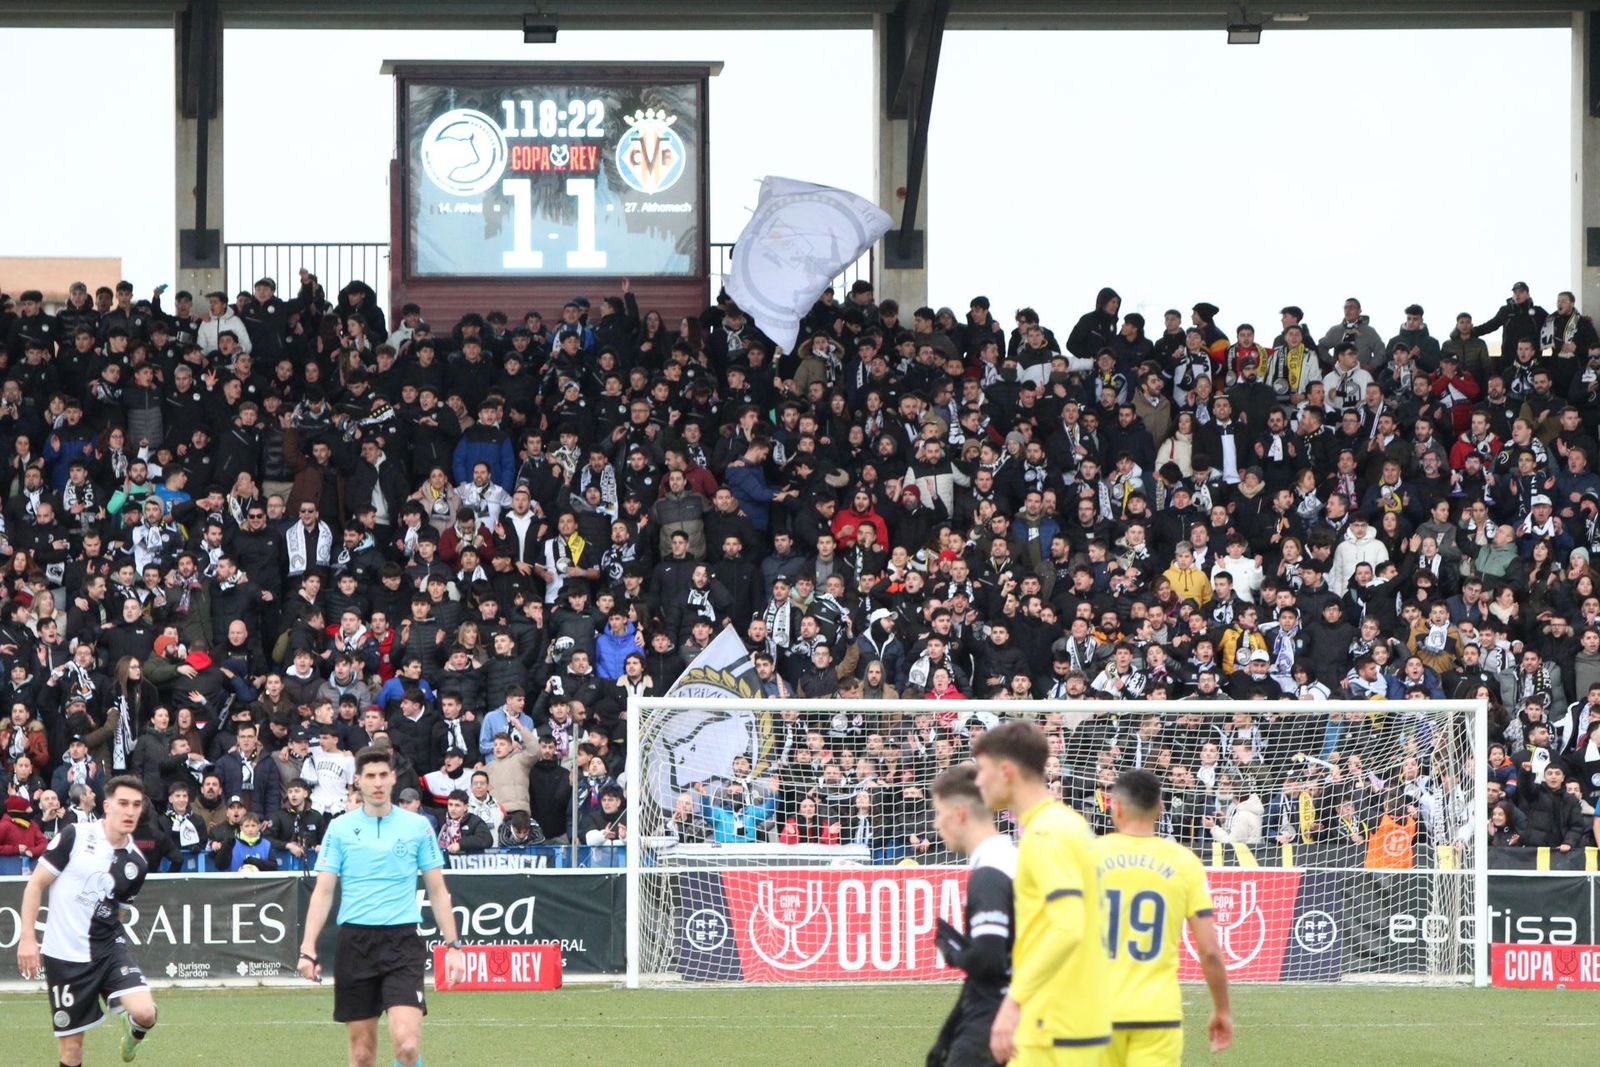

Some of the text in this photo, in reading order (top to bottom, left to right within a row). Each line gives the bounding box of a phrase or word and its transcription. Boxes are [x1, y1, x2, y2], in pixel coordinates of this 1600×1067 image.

[501, 99, 605, 138] 118:22
[511, 145, 597, 171] COPA REY
[502, 178, 543, 269] 1
[566, 178, 607, 269] 1
[449, 853, 548, 870] DISIDENCIA
[780, 894, 801, 909] COPA
[1213, 895, 1235, 909] COPA
[1104, 889, 1166, 962] 19
[511, 951, 542, 983] REY
[1505, 949, 1554, 982] COPA
[52, 984, 74, 1009] 16
